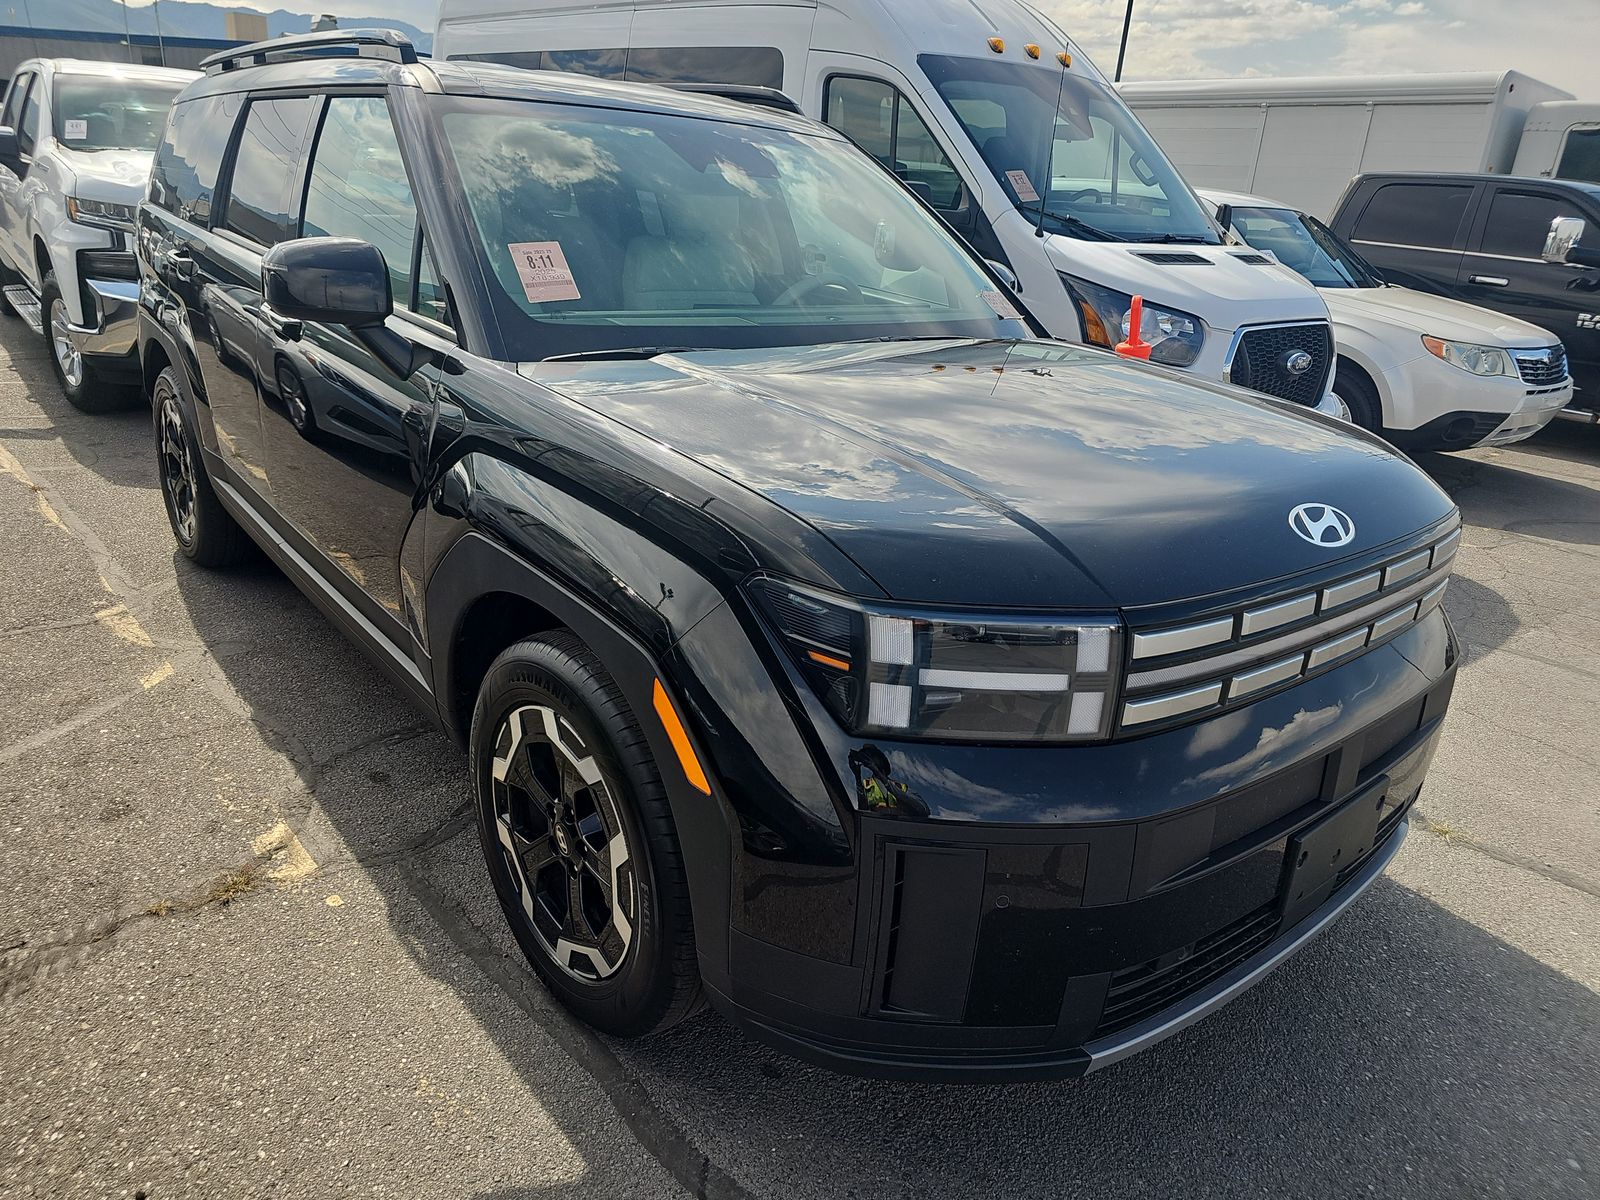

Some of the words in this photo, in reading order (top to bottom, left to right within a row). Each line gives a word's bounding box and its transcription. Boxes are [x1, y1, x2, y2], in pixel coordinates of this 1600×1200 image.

[526, 254, 555, 270] 8:11
[534, 268, 556, 276] 2025
[1577, 313, 1600, 322] RA
[1576, 320, 1600, 330] 150
[508, 671, 577, 714] ASSURANCE
